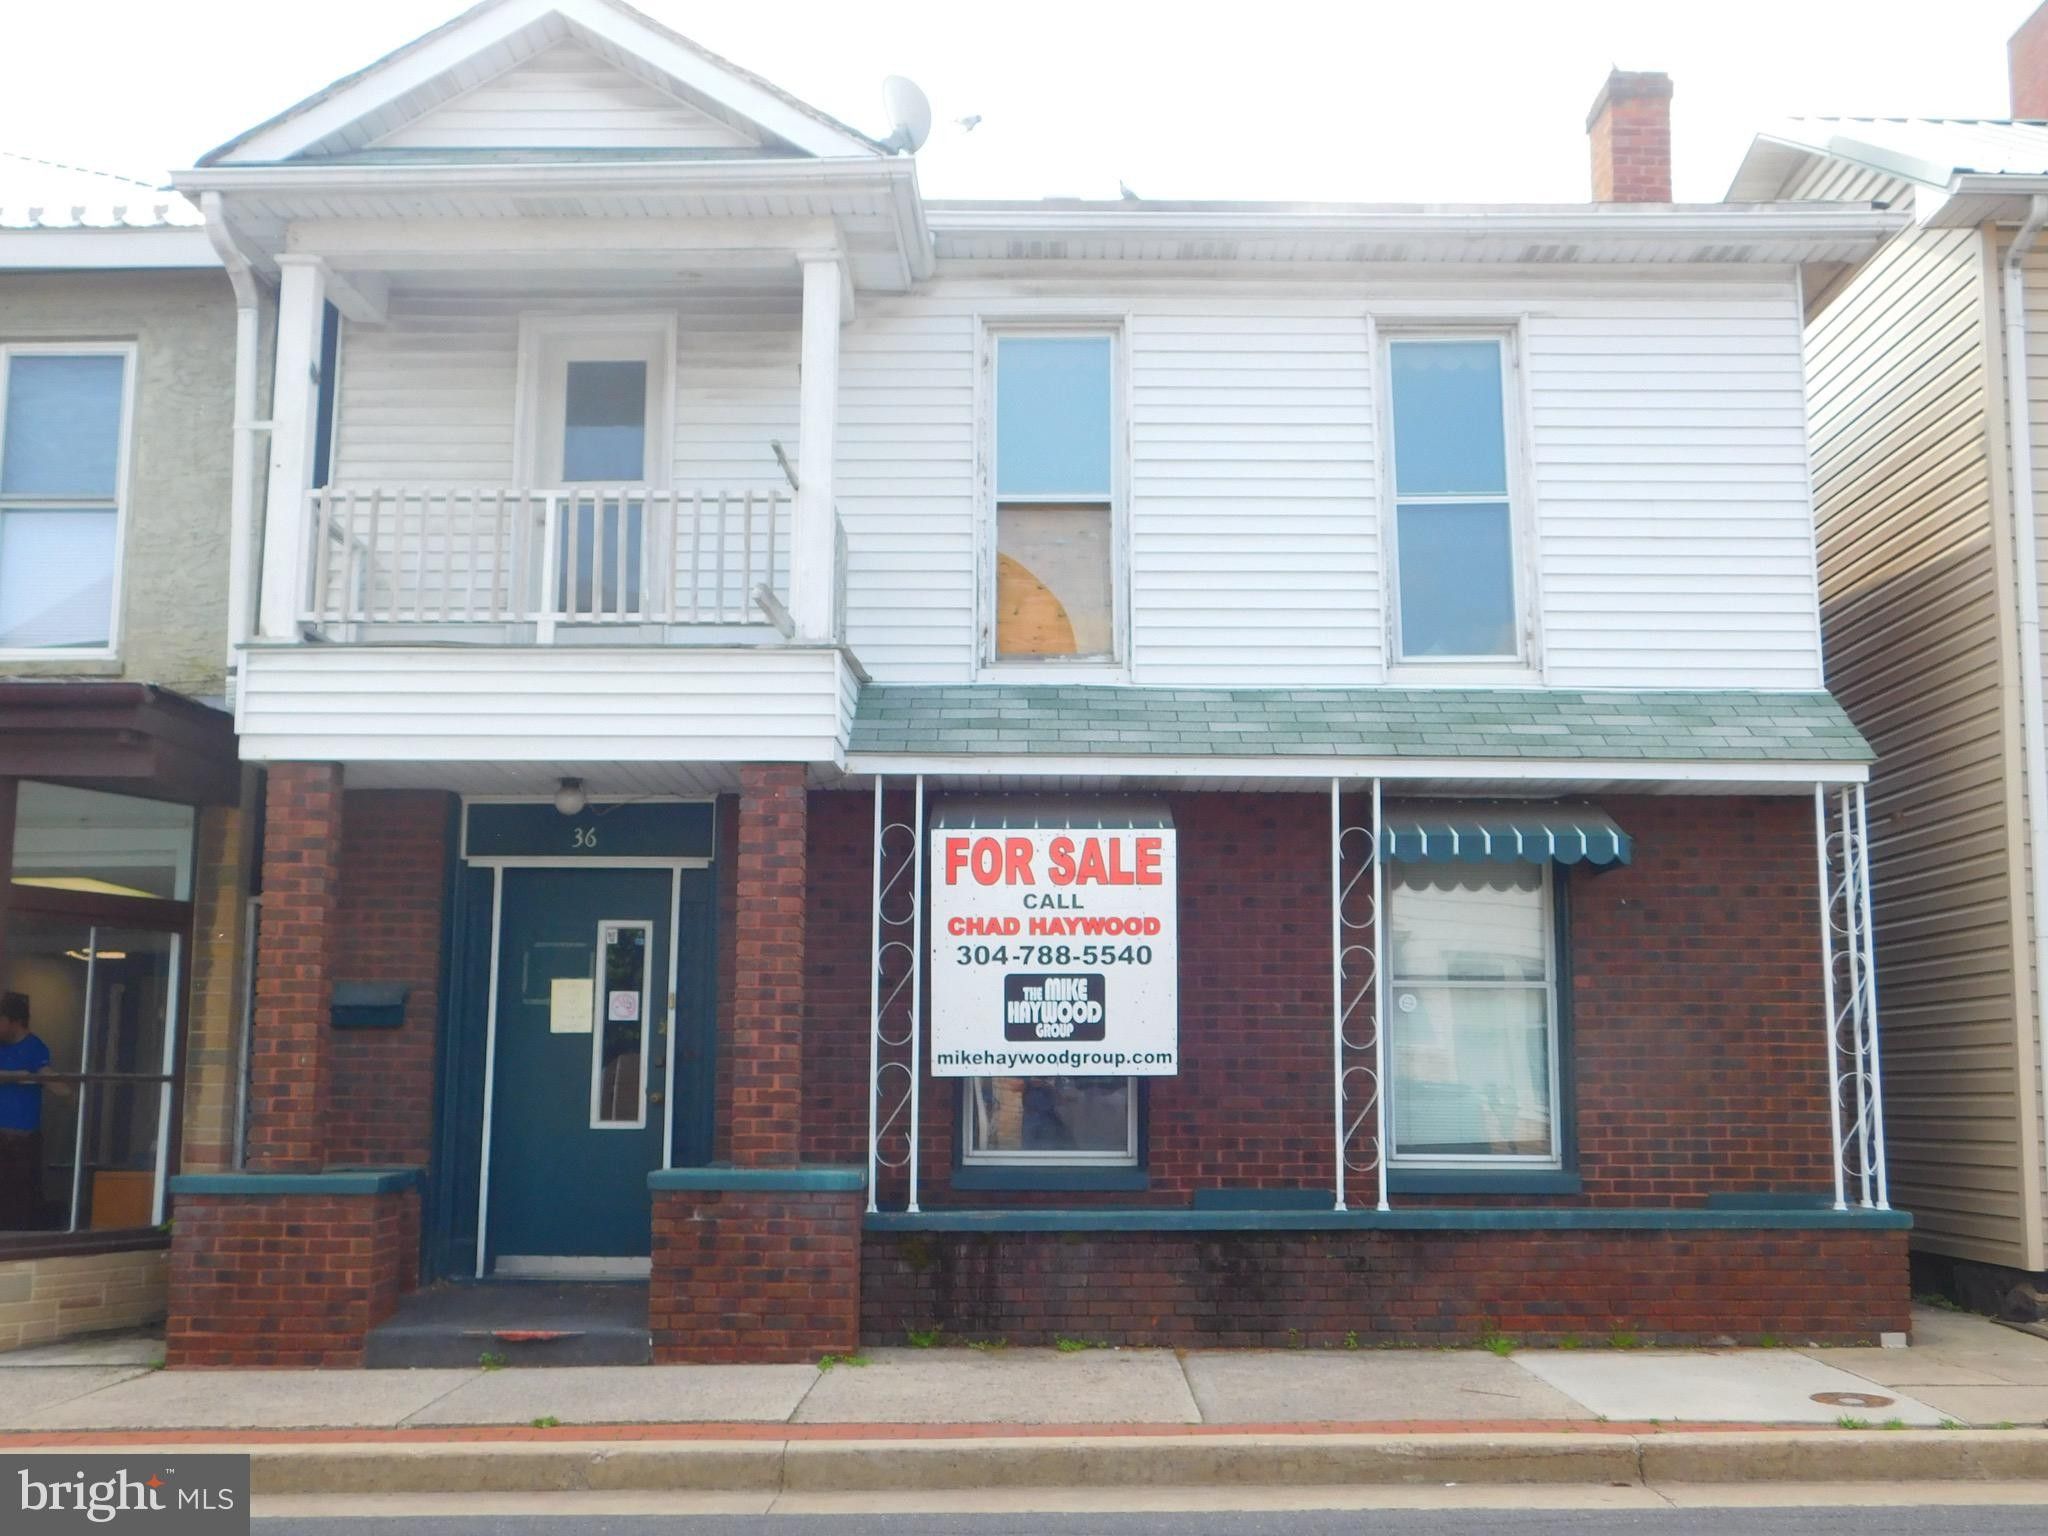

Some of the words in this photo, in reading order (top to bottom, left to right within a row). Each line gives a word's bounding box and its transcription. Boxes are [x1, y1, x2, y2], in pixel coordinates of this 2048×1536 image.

[572, 827, 597, 848] 36
[945, 837, 1036, 886] FOR
[1048, 837, 1163, 886] SALE
[1023, 893, 1084, 909] CALL
[947, 917, 1021, 936] CHAD
[1029, 917, 1161, 936] HAYWOOD
[956, 945, 1153, 966] 304-788-5540
[1023, 987, 1043, 1001] THE
[1044, 978, 1088, 1001] MIKE
[1007, 1001, 1102, 1024] HAYWOOD
[1035, 1023, 1074, 1038] GROUP
[937, 1050, 1172, 1068] mikehaywoodgroup.com
